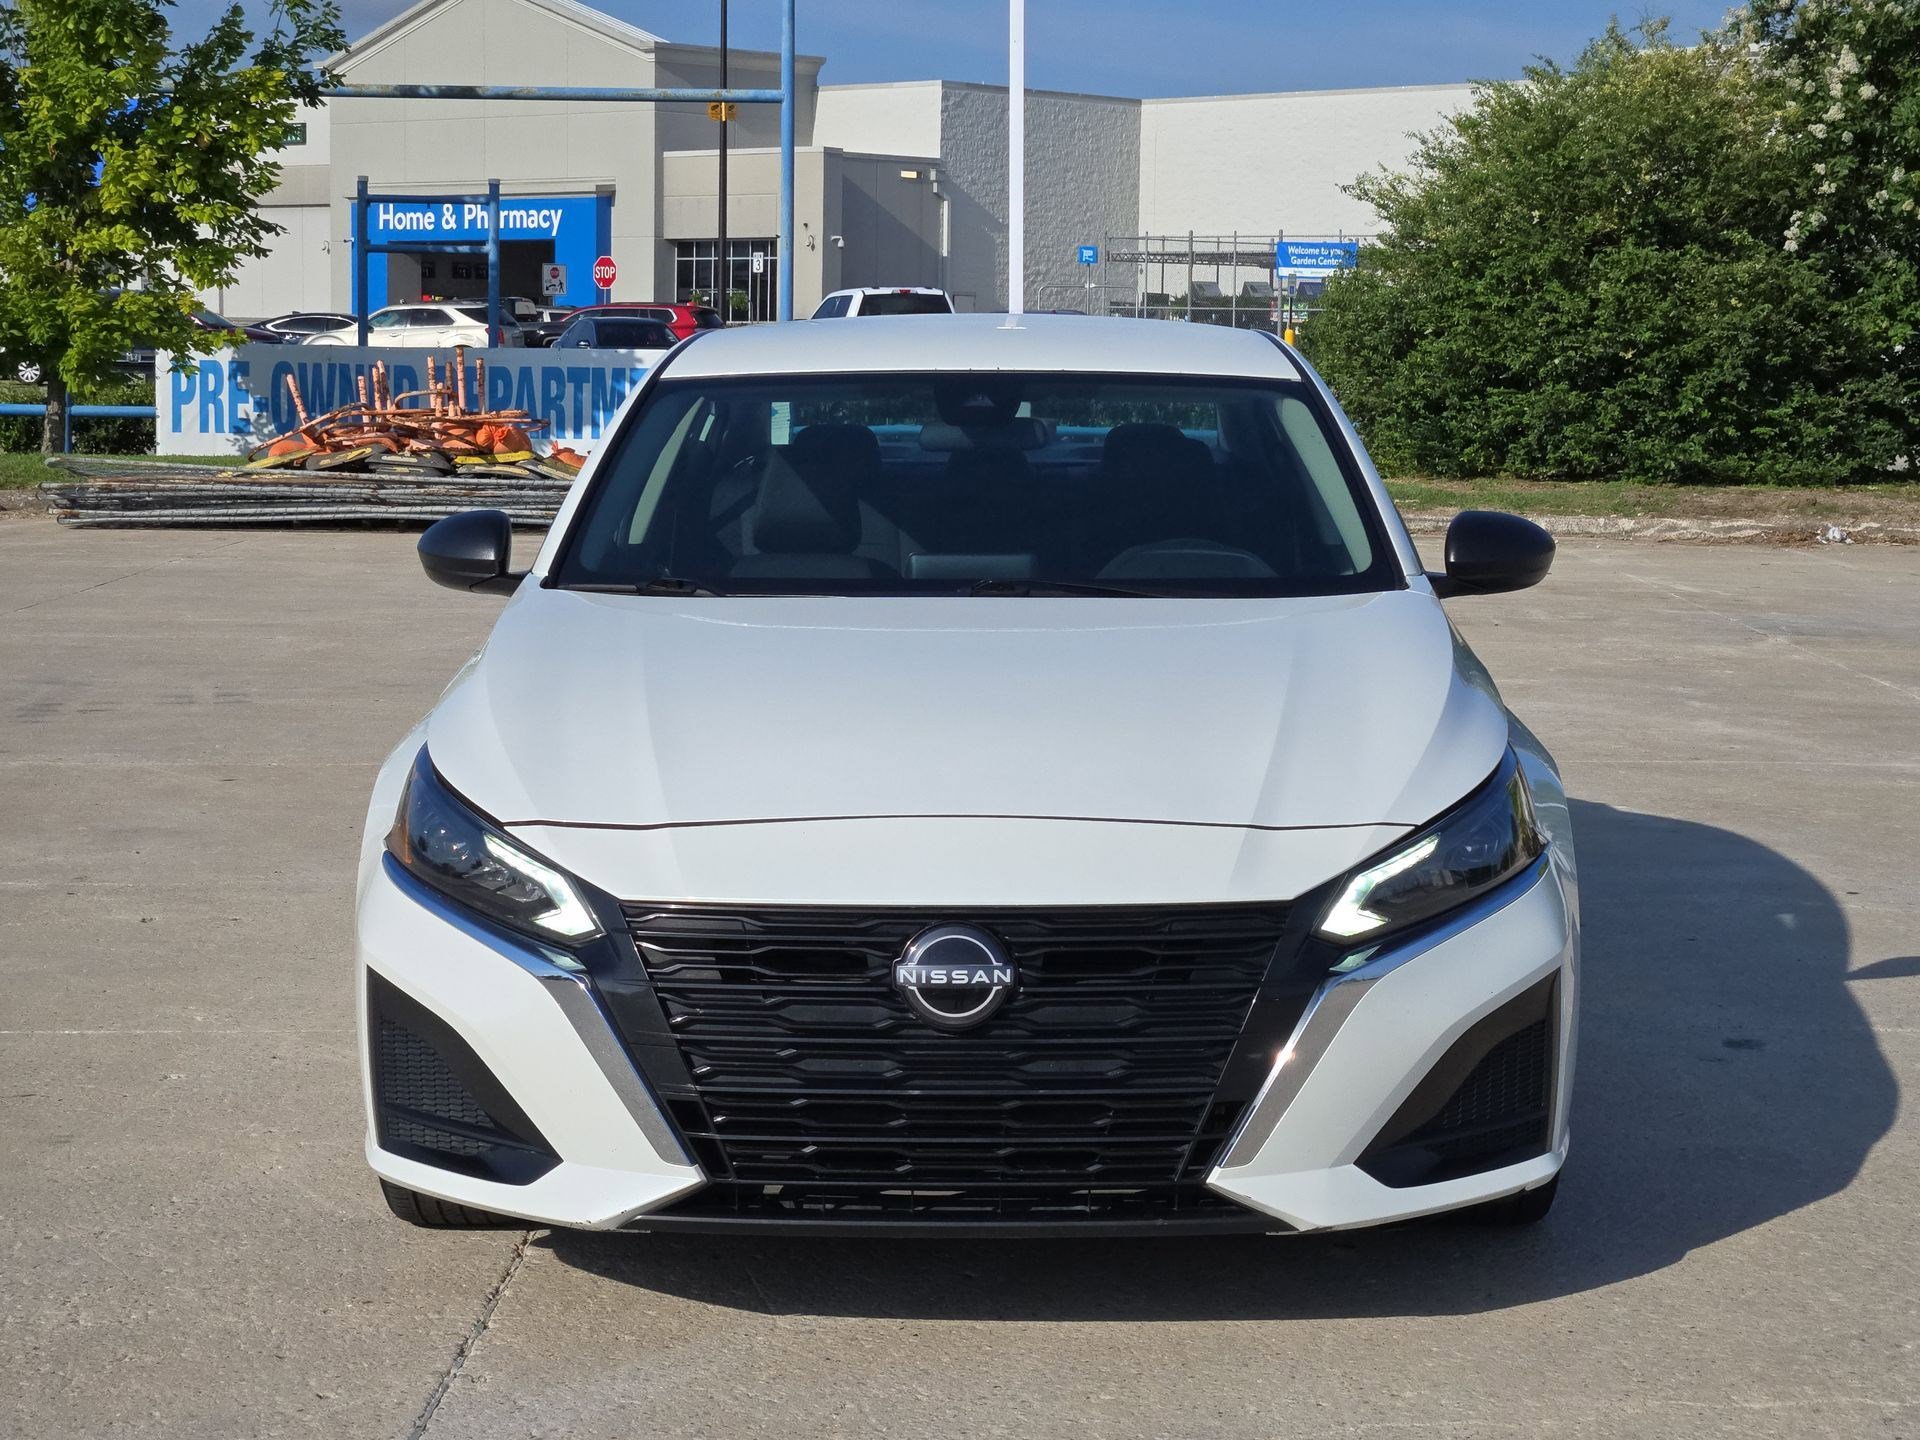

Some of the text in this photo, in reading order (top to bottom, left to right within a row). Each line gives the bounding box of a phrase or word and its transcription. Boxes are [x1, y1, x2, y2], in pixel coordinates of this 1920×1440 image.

[379, 203, 563, 237] Home & Phrmacy
[1288, 246, 1320, 255] Welcome
[1321, 247, 1328, 255] to
[755, 259, 761, 271] 3
[1291, 256, 1316, 265] Garden
[595, 266, 615, 279] STOP
[433, 365, 652, 439] EPARTM
[899, 968, 1011, 984] NISSAN
